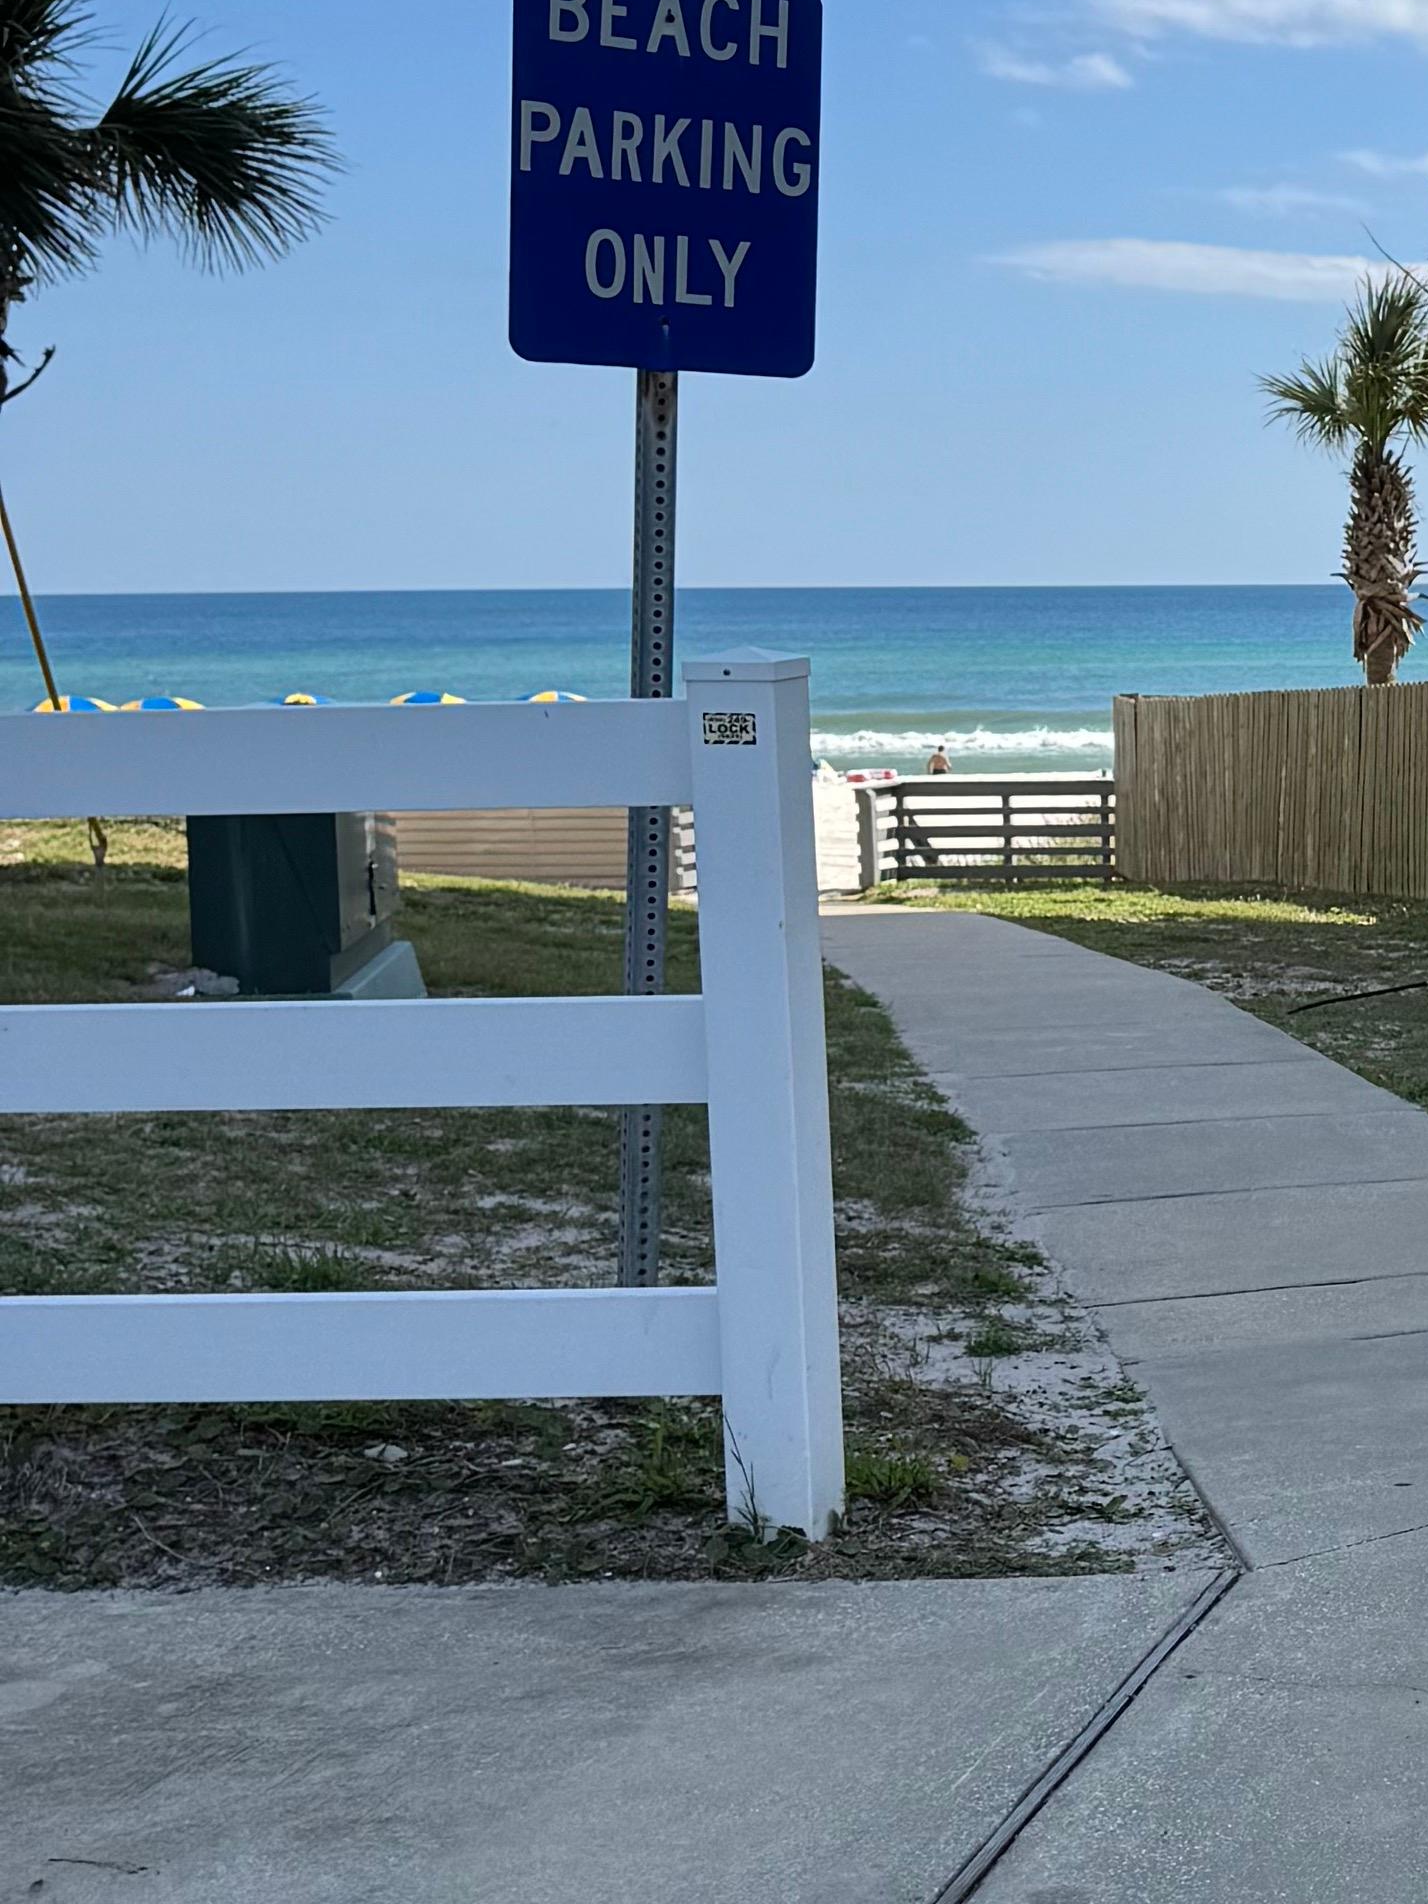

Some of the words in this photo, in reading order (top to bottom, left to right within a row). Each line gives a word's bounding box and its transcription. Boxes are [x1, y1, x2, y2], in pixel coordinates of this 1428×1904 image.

[520, 99, 811, 197] PARKING
[585, 228, 751, 307] ONLY
[709, 724, 750, 734] LOCK
